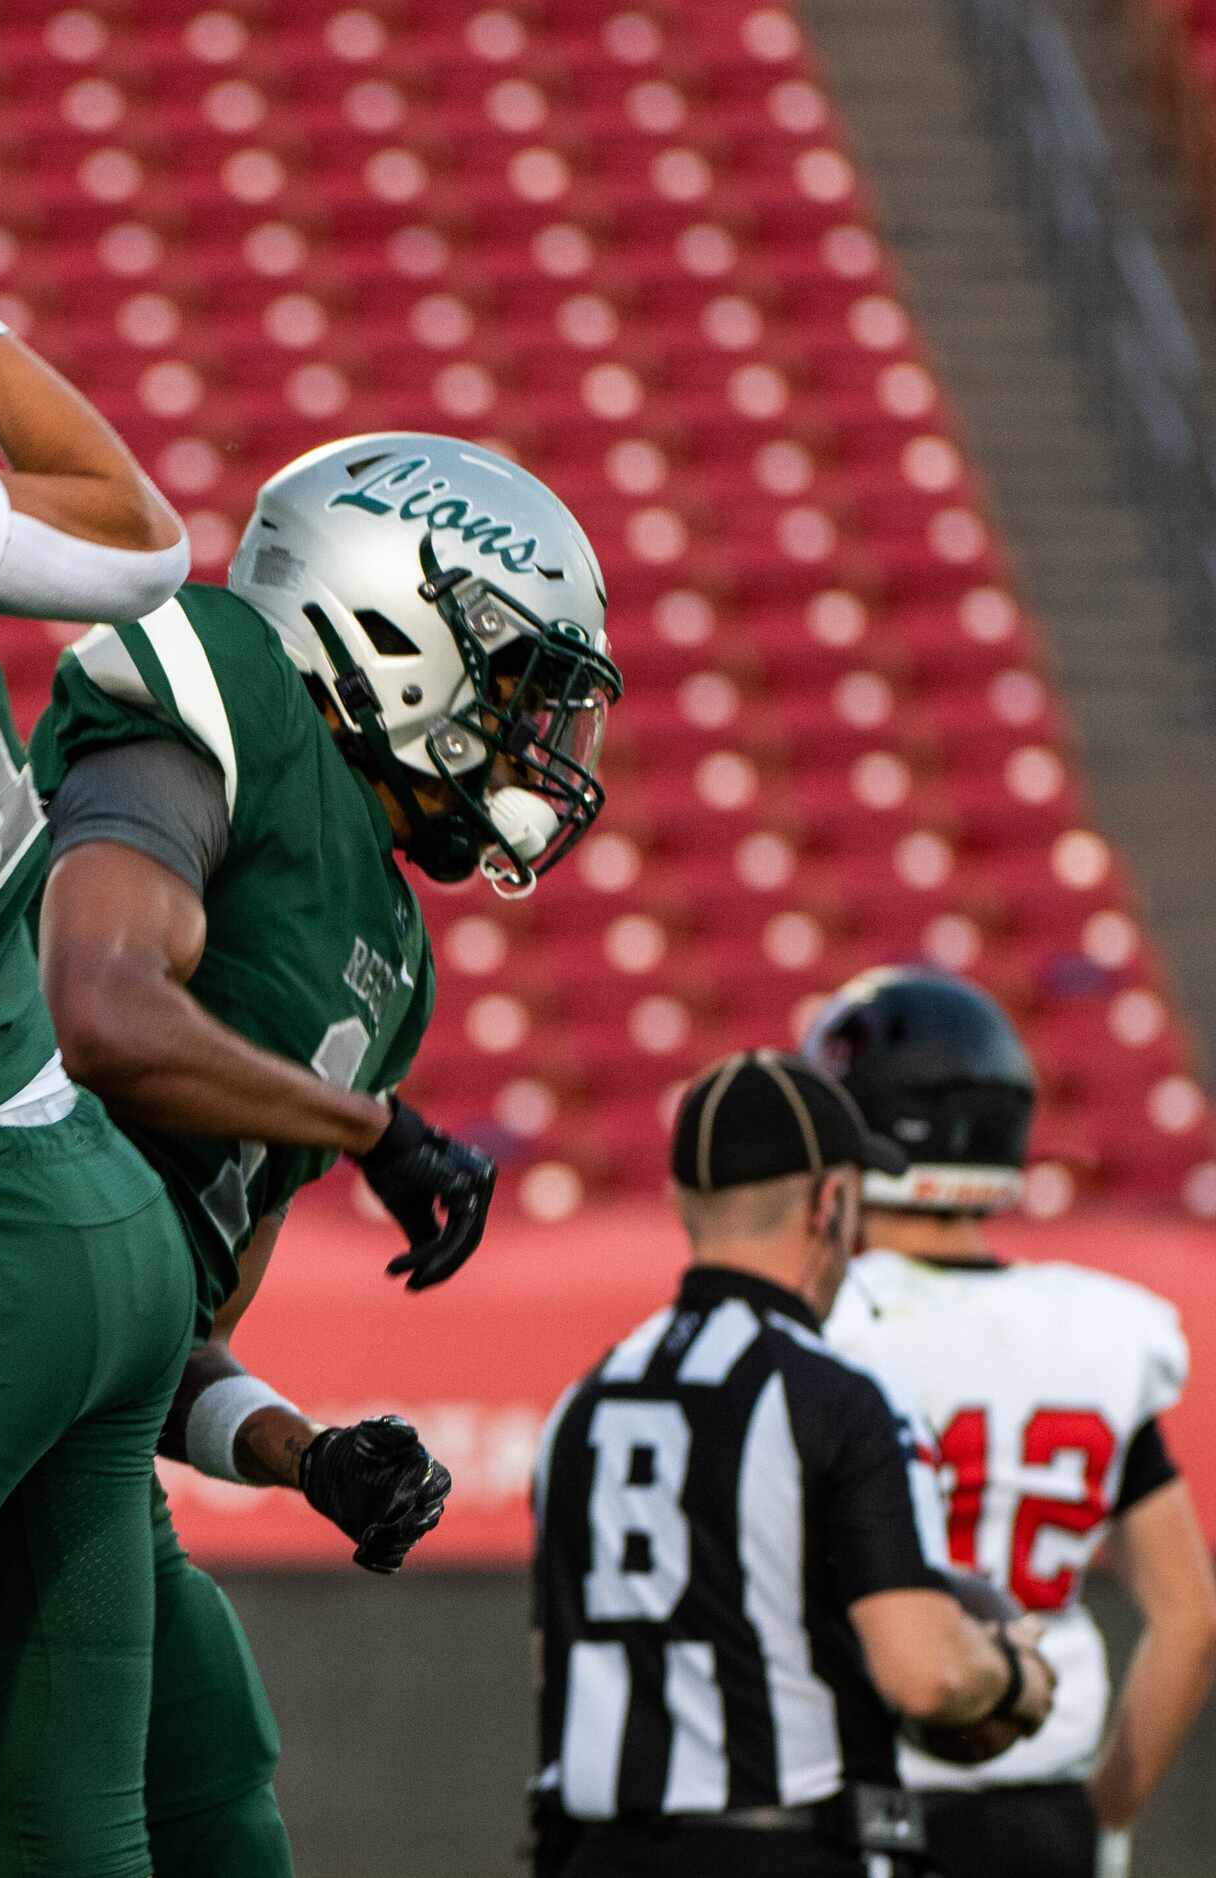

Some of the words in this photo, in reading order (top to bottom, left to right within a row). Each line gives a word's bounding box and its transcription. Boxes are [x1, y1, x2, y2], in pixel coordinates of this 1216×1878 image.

[326, 457, 540, 575] Lions
[586, 1399, 691, 1621] B
[935, 1407, 1117, 1612] 12
